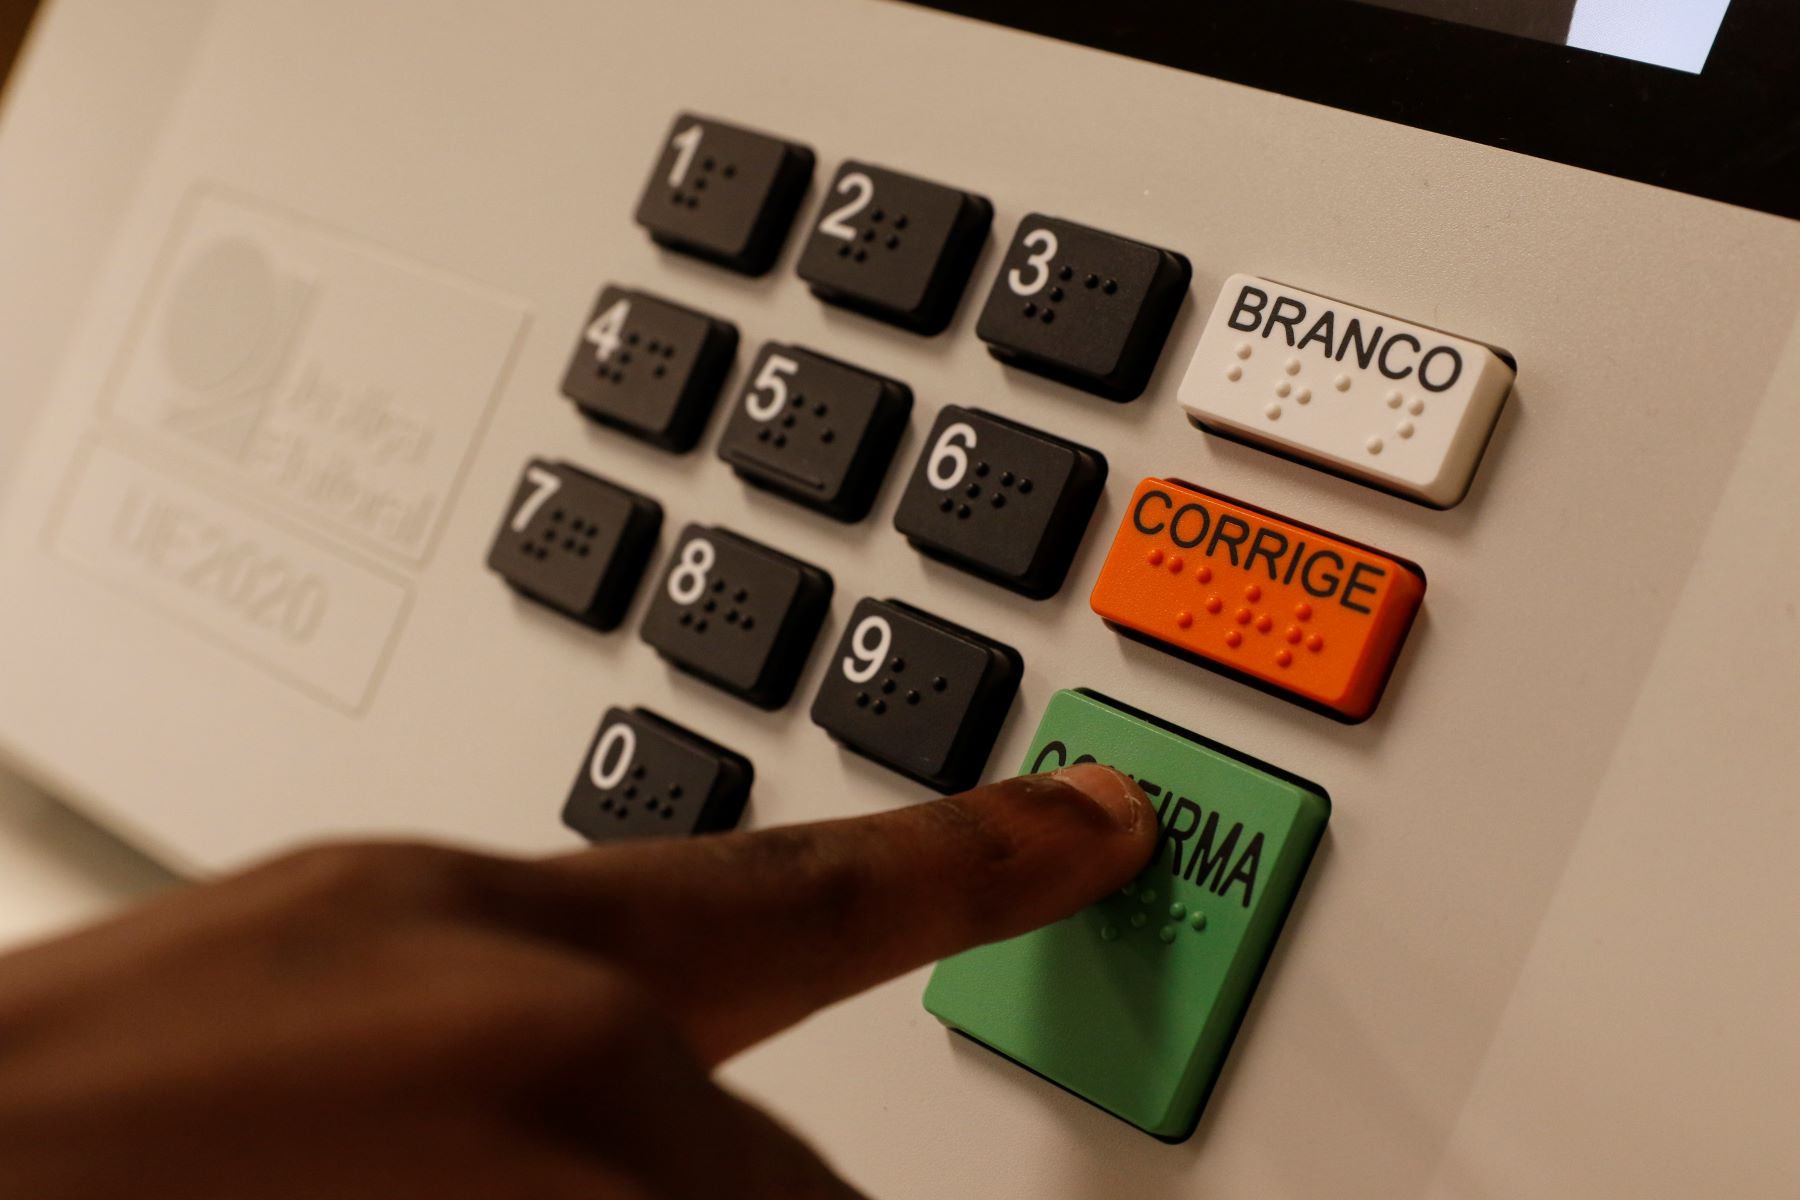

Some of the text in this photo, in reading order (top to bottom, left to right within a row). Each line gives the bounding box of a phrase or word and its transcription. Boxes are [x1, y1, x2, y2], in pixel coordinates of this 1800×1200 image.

[668, 124, 704, 189] 1
[818, 172, 875, 241] 2
[1006, 228, 1059, 297] 3
[585, 298, 631, 362] 4
[1227, 285, 1463, 393] BRANCO
[744, 354, 799, 423] 5
[925, 422, 978, 491] 6
[510, 468, 560, 533] 7
[667, 538, 716, 606] 8
[1132, 490, 1386, 615] CORRIGE
[841, 615, 893, 684] 9
[588, 722, 637, 791] 0
